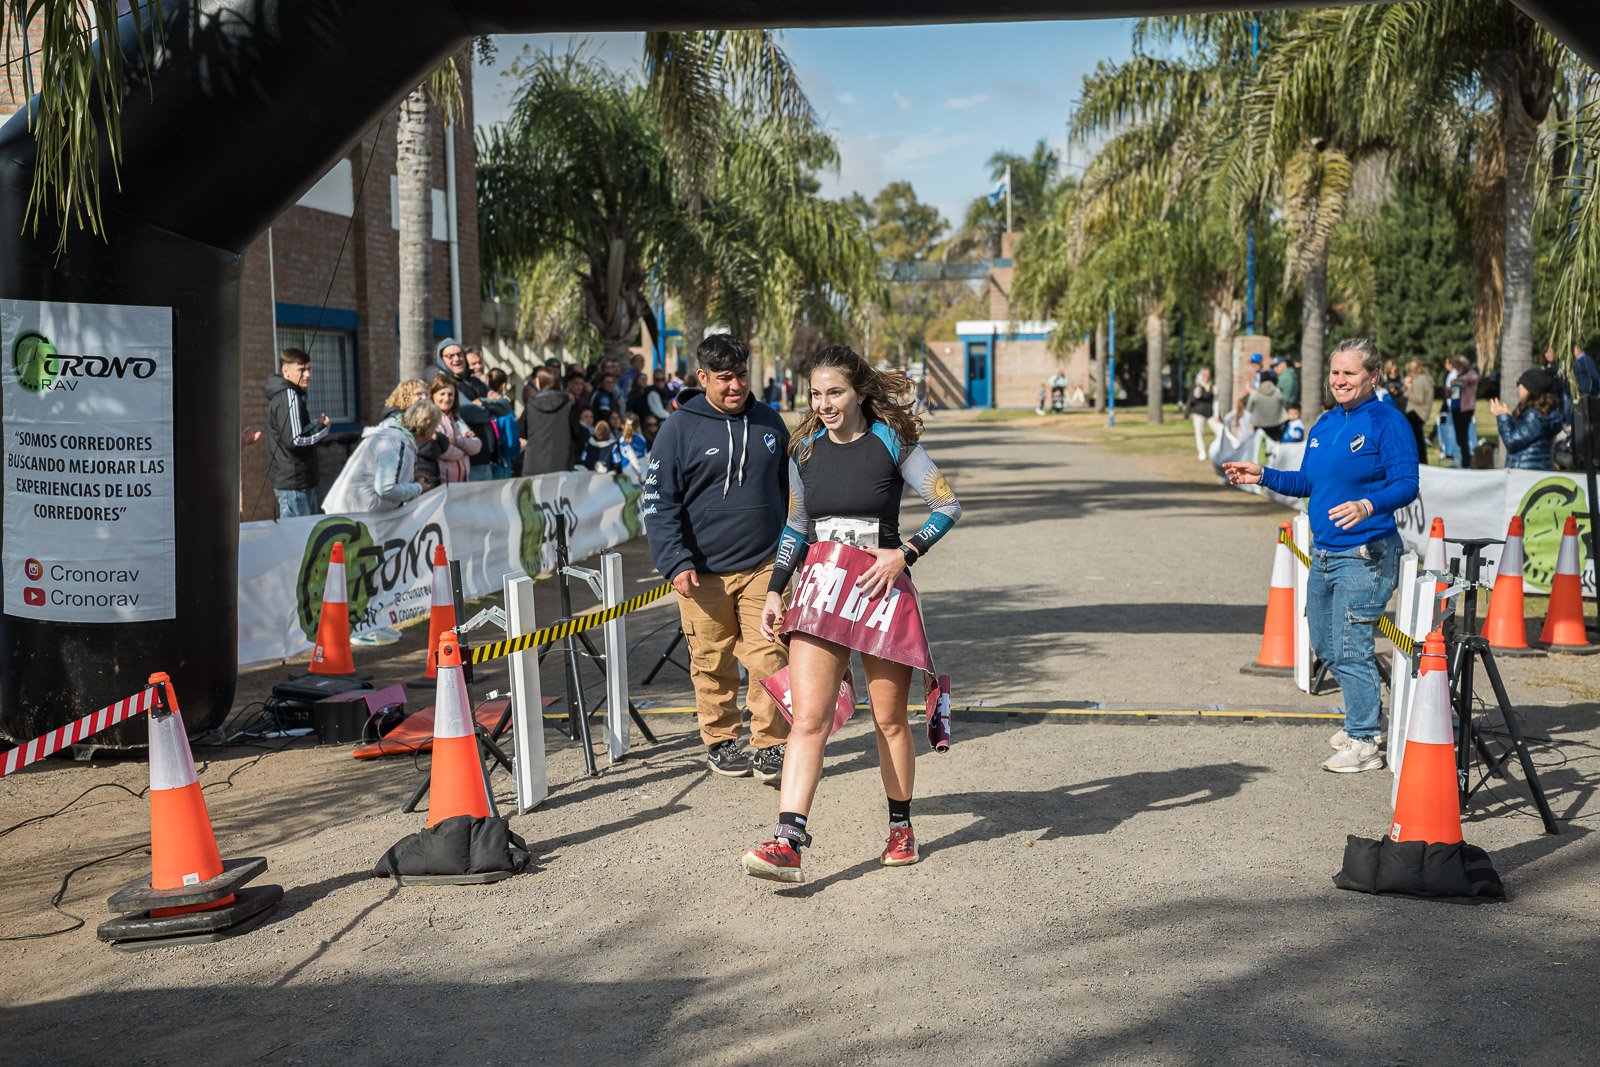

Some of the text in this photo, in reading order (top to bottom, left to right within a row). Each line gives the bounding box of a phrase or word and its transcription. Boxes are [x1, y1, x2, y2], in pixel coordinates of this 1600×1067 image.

[43, 353, 157, 379] CRONO
[41, 379, 79, 392] RAV
[60, 434, 153, 451] CORREDORES
[8, 453, 165, 475] BUSCANDO MEJORAR LAS
[16, 477, 152, 498] EXPERIENCIAS DE LOS
[50, 564, 140, 583] Cronorav
[50, 589, 140, 607] Cronorav
